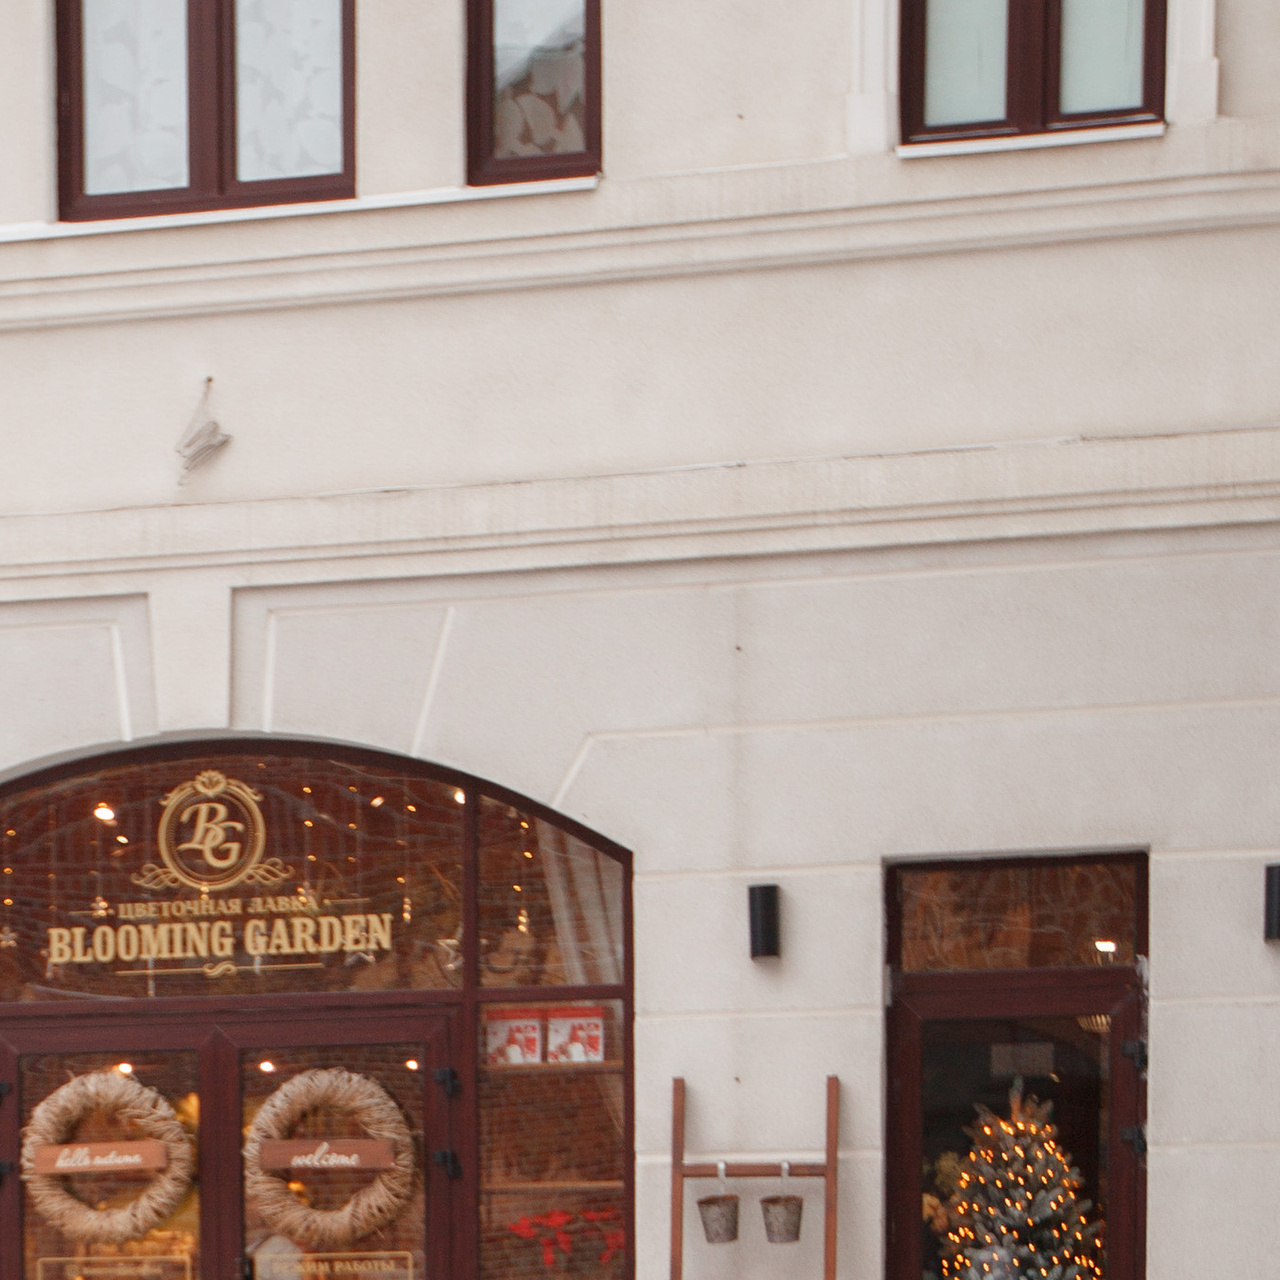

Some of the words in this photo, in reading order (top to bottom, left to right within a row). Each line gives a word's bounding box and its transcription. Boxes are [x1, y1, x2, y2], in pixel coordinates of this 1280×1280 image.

[118, 897, 243, 920] ЦВЕТОЧНАЯ
[247, 895, 320, 913] ЛАВКА
[47, 920, 236, 964] BLOOMING
[244, 913, 394, 956] GARDEN
[290, 1141, 361, 1168] welcome
[333, 1259, 395, 1273] РАБОТЫ
